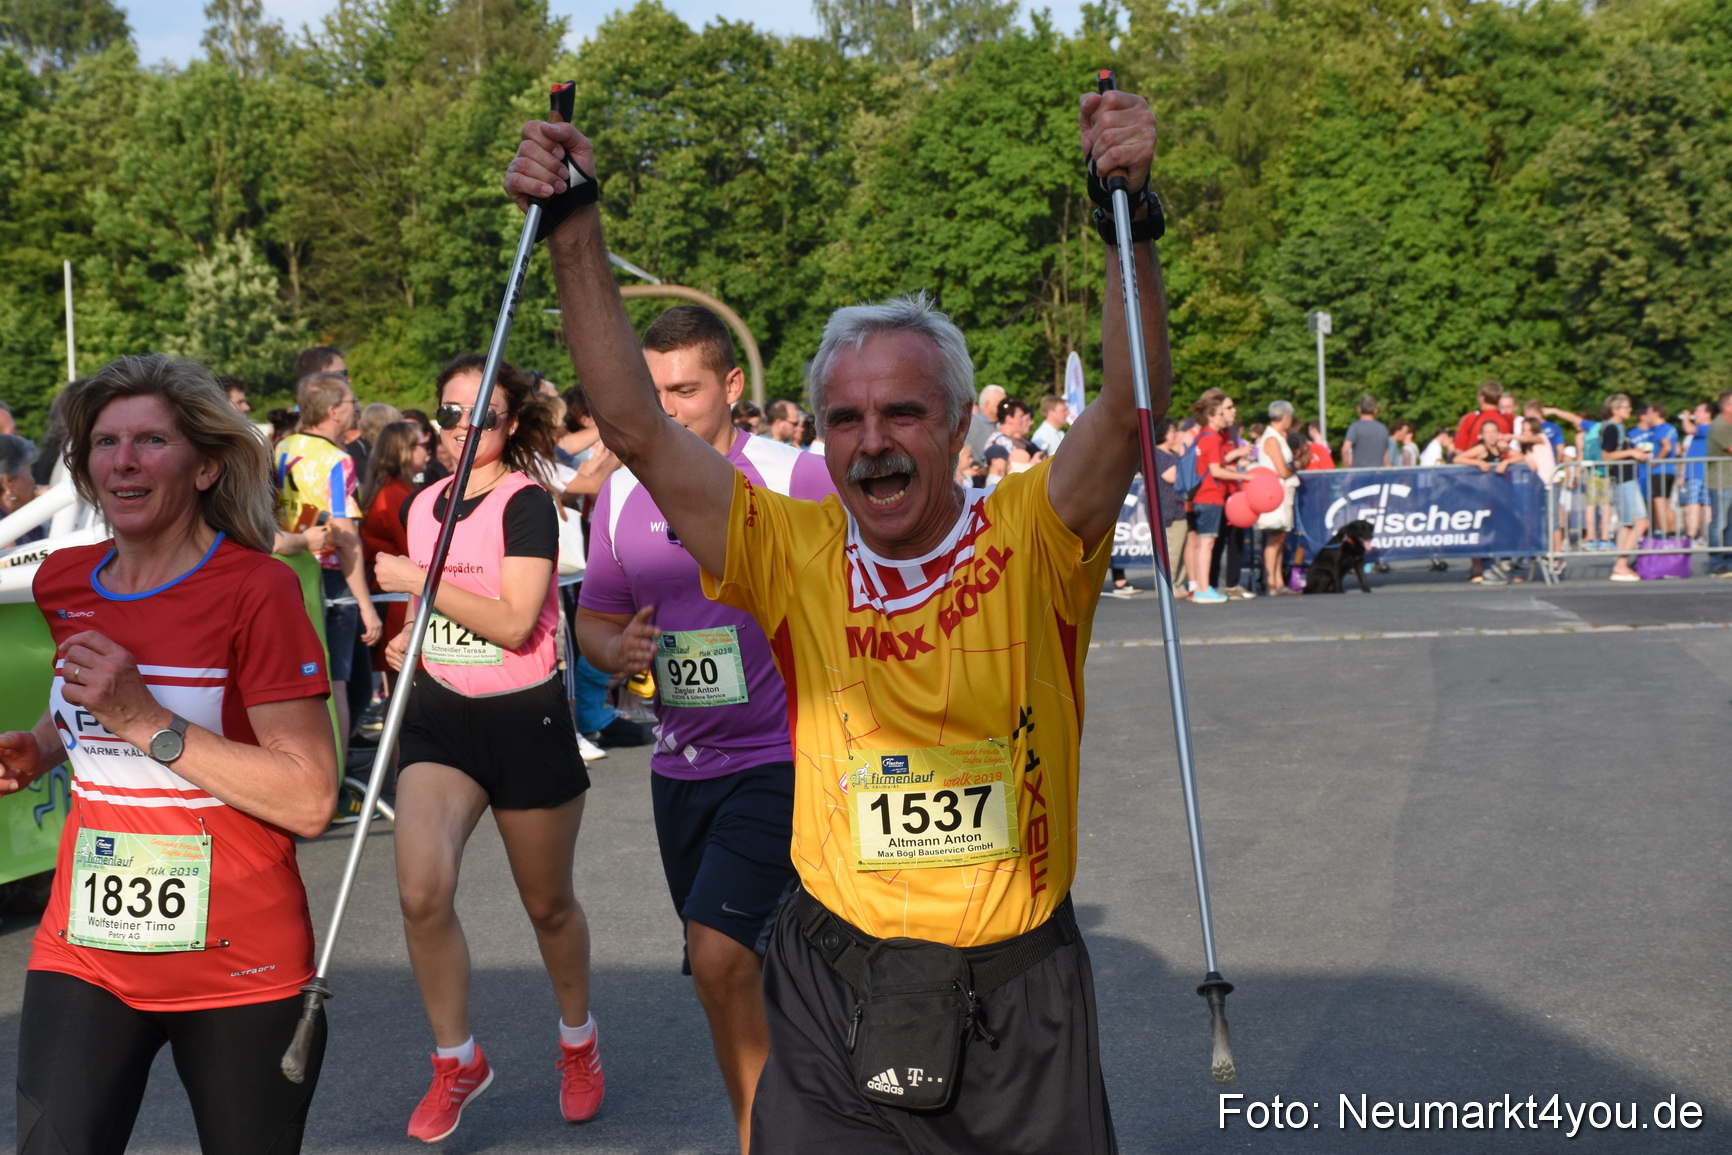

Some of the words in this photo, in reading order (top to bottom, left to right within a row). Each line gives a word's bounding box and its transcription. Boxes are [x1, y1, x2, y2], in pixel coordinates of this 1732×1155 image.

[1358, 505, 1491, 534] Fischer
[1370, 532, 1480, 549] AUTOMOBILE
[845, 623, 936, 662] MAX
[939, 545, 1014, 640] BÖGL
[713, 647, 733, 656] 2019
[668, 658, 718, 686] 920
[674, 687, 695, 695] Ziegler
[697, 686, 719, 694] Anton
[871, 770, 935, 784] firmenlauf
[943, 772, 973, 787] walk
[974, 772, 1002, 785] 2019
[870, 785, 992, 835] 1537
[888, 836, 940, 848] Altmann
[944, 833, 982, 845] Anton
[877, 850, 894, 858] Max
[896, 849, 916, 859] Bögl
[918, 846, 965, 857] Bauservice
[967, 842, 994, 852] GmbH
[87, 854, 134, 868] firmenlauf
[170, 867, 199, 876] 2019
[85, 872, 186, 919] 1836
[87, 916, 141, 931] Wolfsteiner
[145, 920, 176, 931] Timo
[108, 931, 126, 941] Petry
[128, 932, 141, 940] AG
[867, 1080, 904, 1095] adidas
